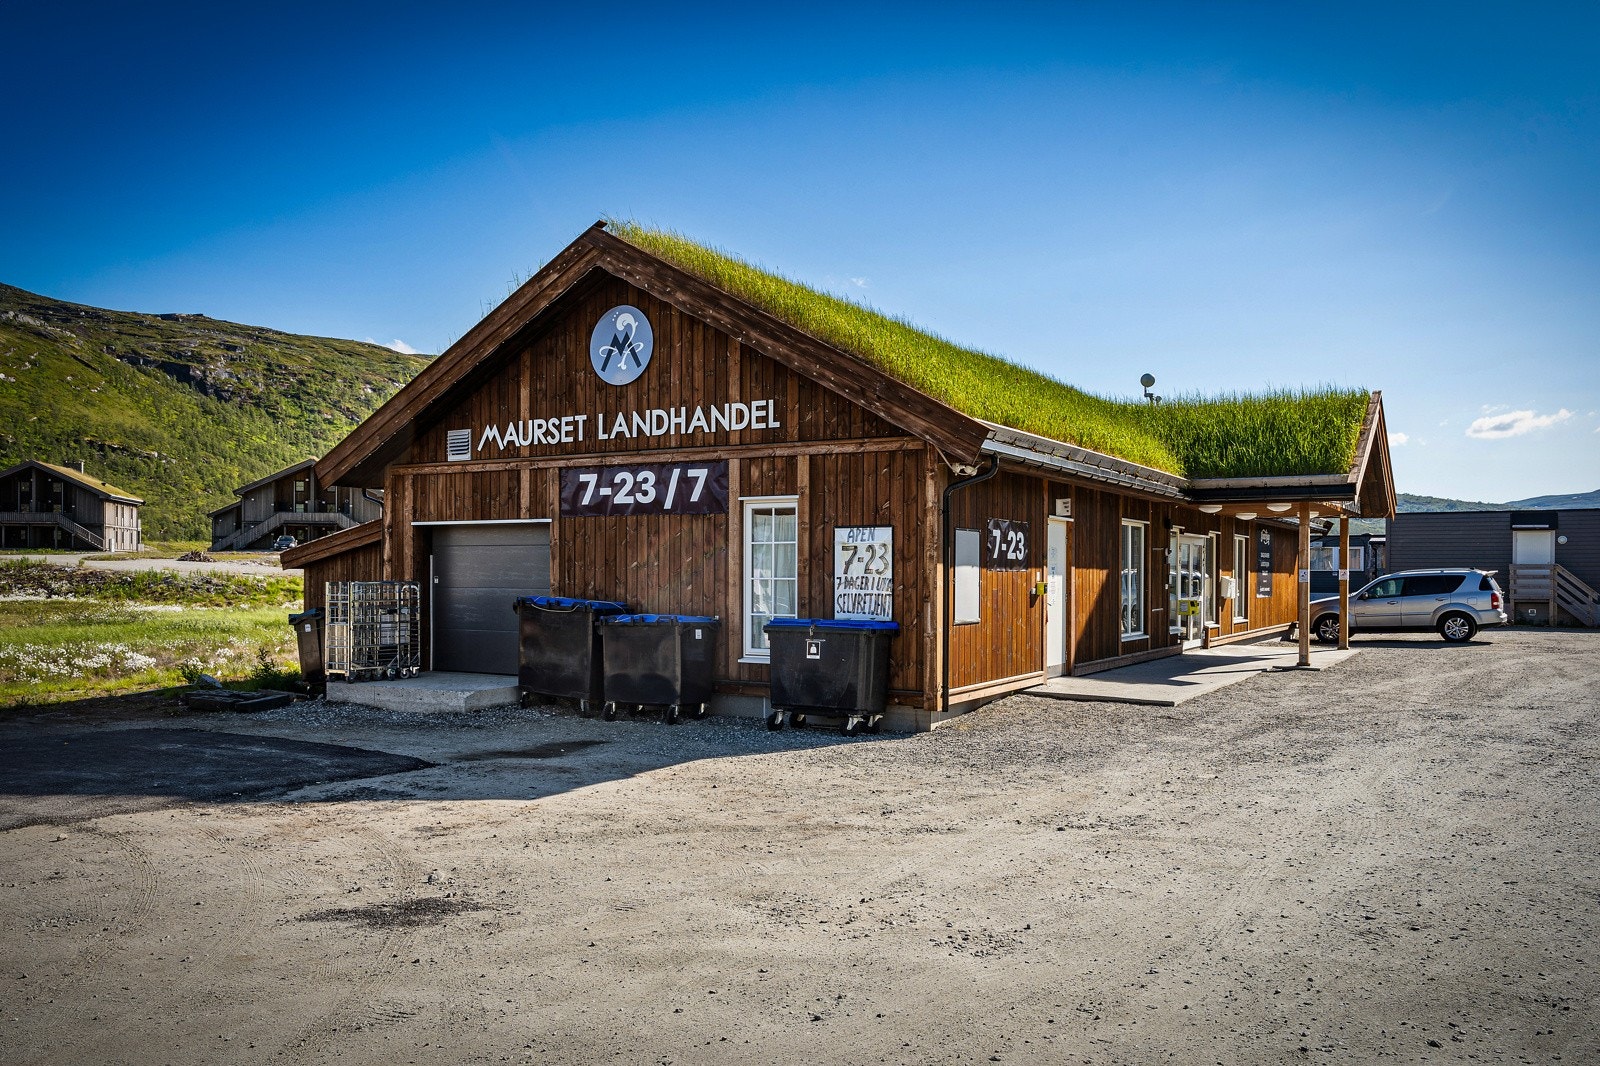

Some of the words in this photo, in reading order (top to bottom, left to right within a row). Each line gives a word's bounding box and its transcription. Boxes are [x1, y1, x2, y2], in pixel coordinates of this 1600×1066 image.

[478, 414, 587, 451] MAURSET
[598, 399, 780, 440] LANDHANDEL
[842, 543, 889, 576] 7-23
[993, 529, 1024, 560] 7-23
